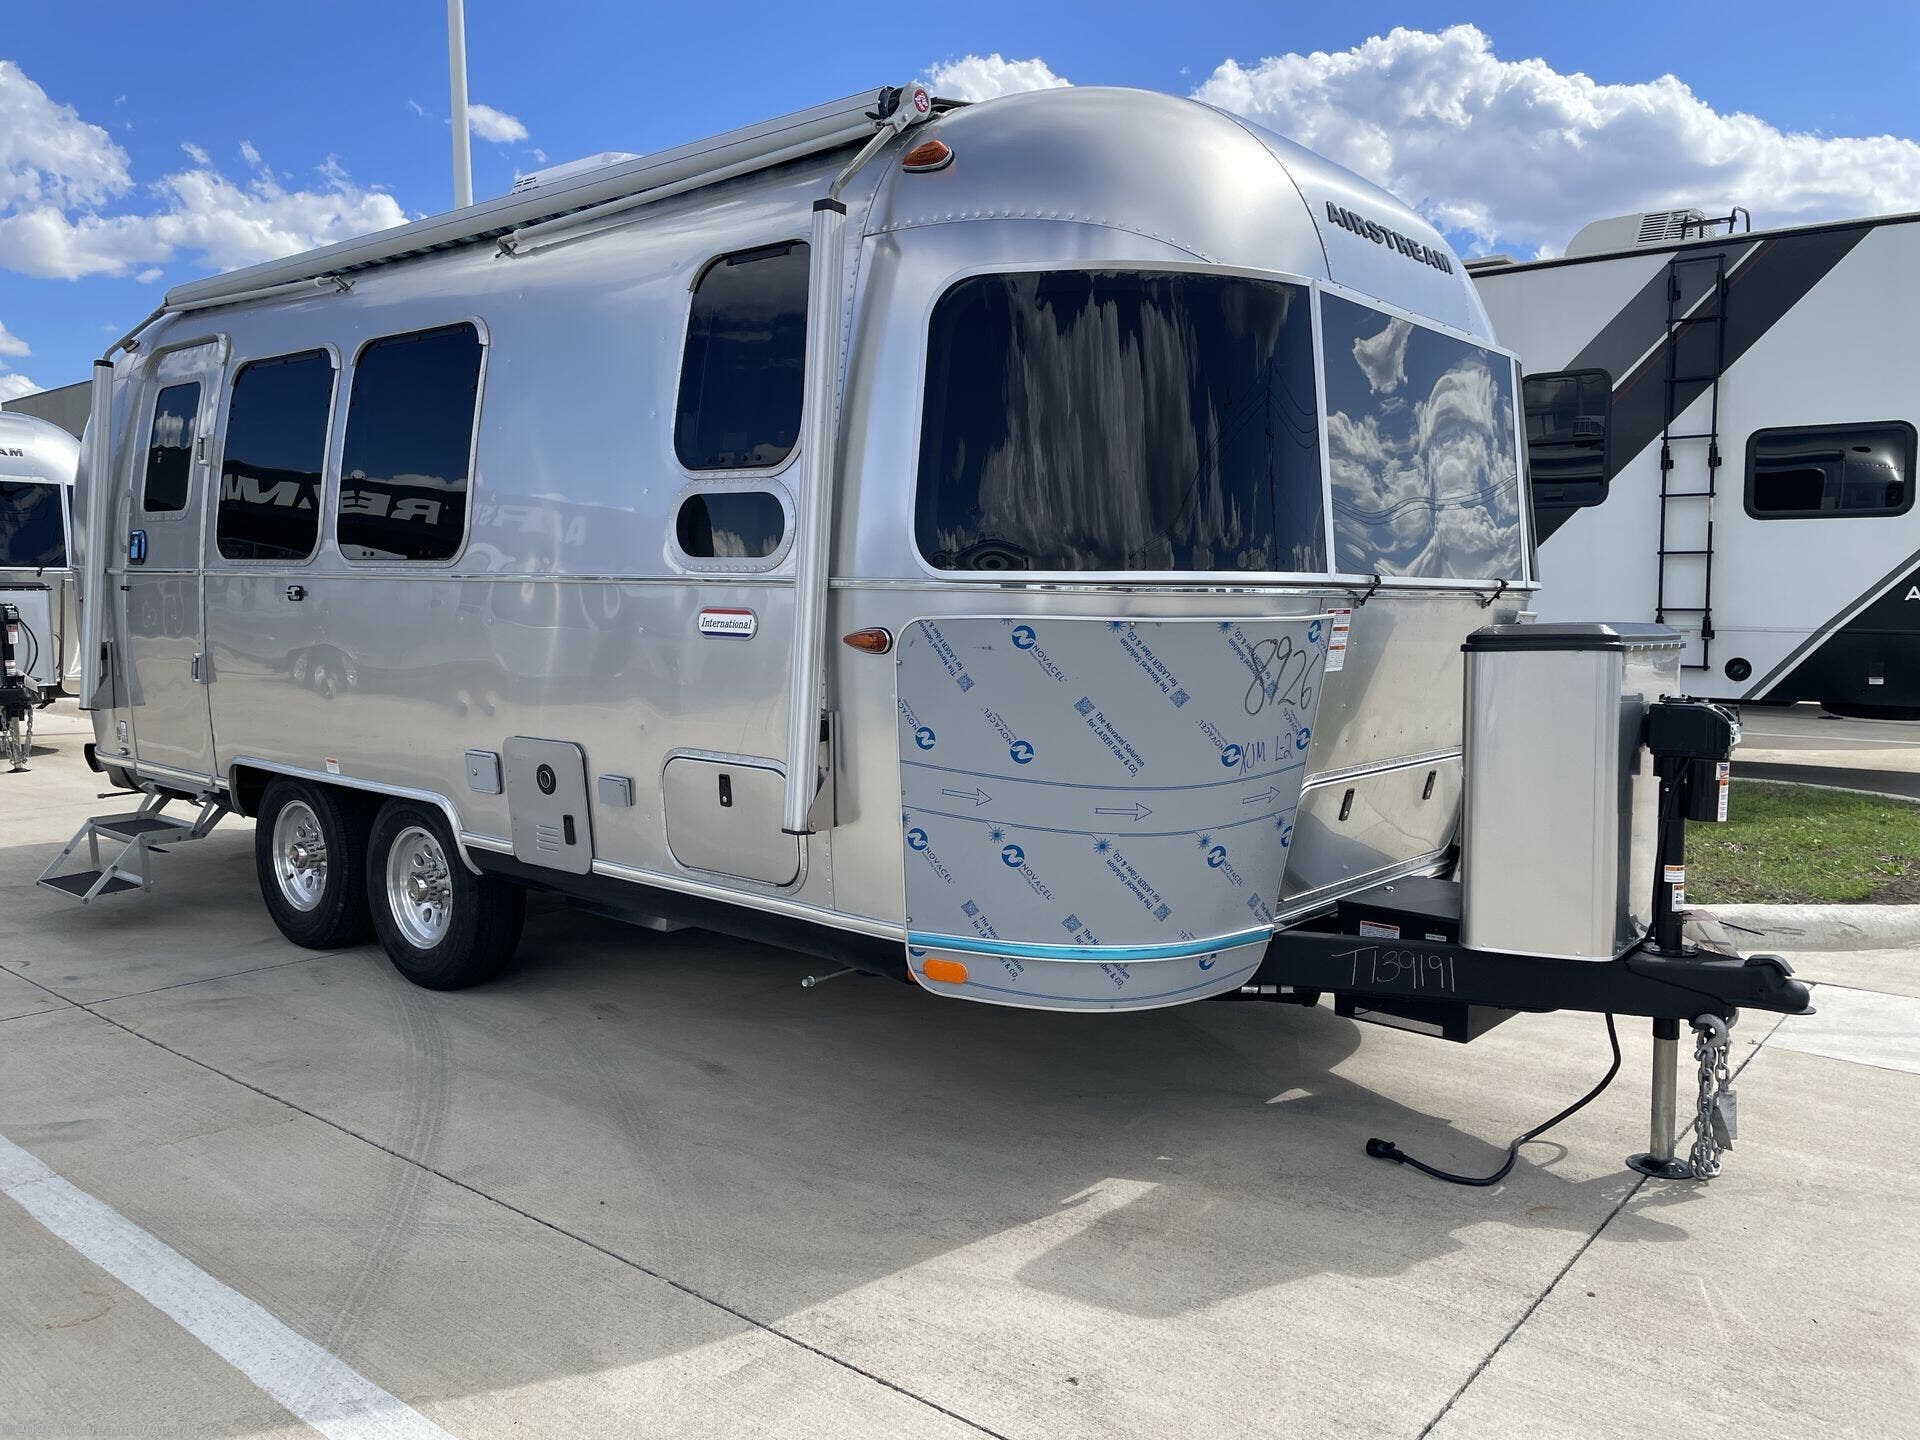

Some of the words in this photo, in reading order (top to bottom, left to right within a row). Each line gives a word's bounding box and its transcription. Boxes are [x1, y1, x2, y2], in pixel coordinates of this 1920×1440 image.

[1326, 201, 1453, 275] AIRSTREAM
[701, 617, 752, 629] International
[1032, 645, 1065, 682] NOVACEL
[1120, 638, 1142, 663] Solution
[1141, 645, 1156, 662] Fiber
[1138, 661, 1161, 685] Novacel
[1152, 659, 1171, 679] LASER
[1169, 677, 1178, 687] for
[1245, 636, 1320, 716] 8926
[1159, 681, 1170, 695] The
[984, 708, 1014, 745] NOVACEL
[1087, 718, 1096, 729] for
[1094, 727, 1114, 747] LASER
[1111, 745, 1126, 761] Fiber
[1095, 711, 1106, 725] The
[1104, 722, 1127, 746] Novacel
[1123, 743, 1145, 768] Solution
[924, 847, 952, 884] NOVACEL
[1021, 863, 1052, 900] NOVACEL
[1137, 877, 1155, 896] LASER
